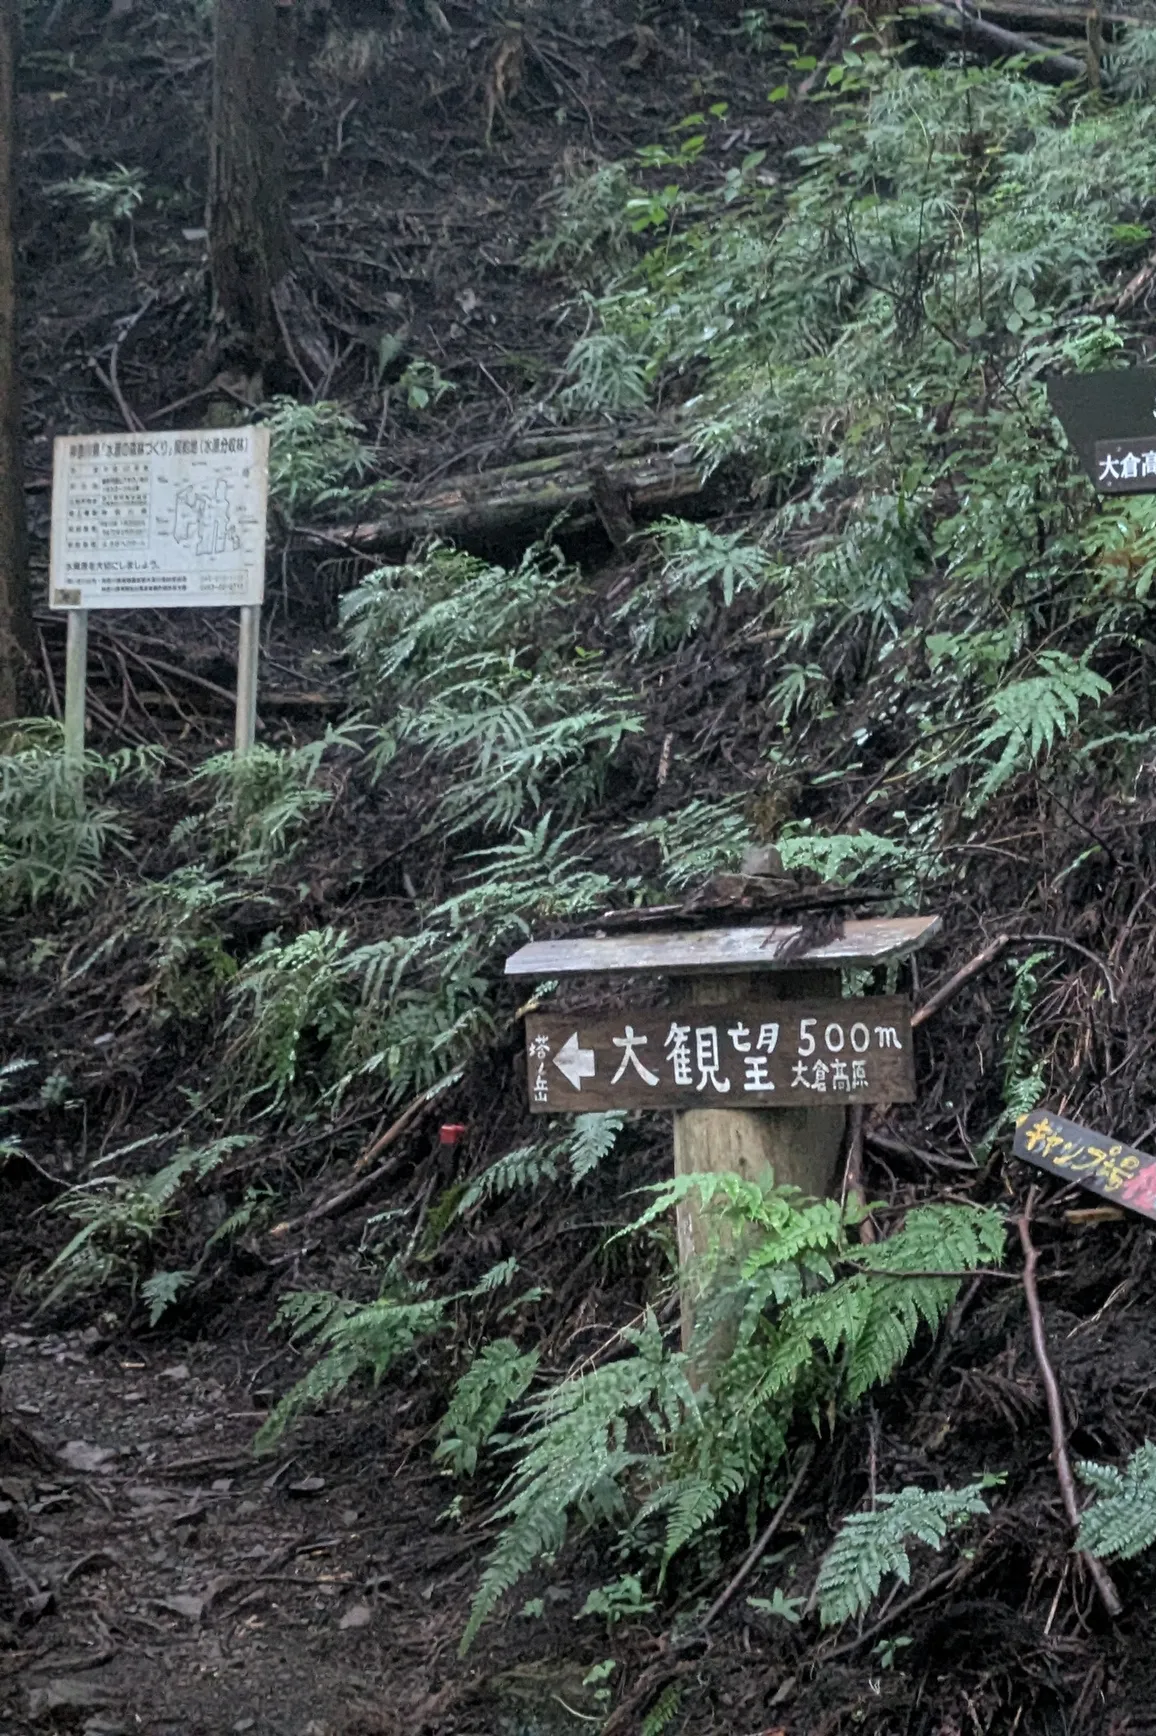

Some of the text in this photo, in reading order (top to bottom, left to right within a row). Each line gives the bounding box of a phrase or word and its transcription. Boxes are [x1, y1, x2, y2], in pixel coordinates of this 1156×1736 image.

[611, 1018, 902, 1093] 大観望 500m
[791, 1058, 869, 1093] 大倉高原
